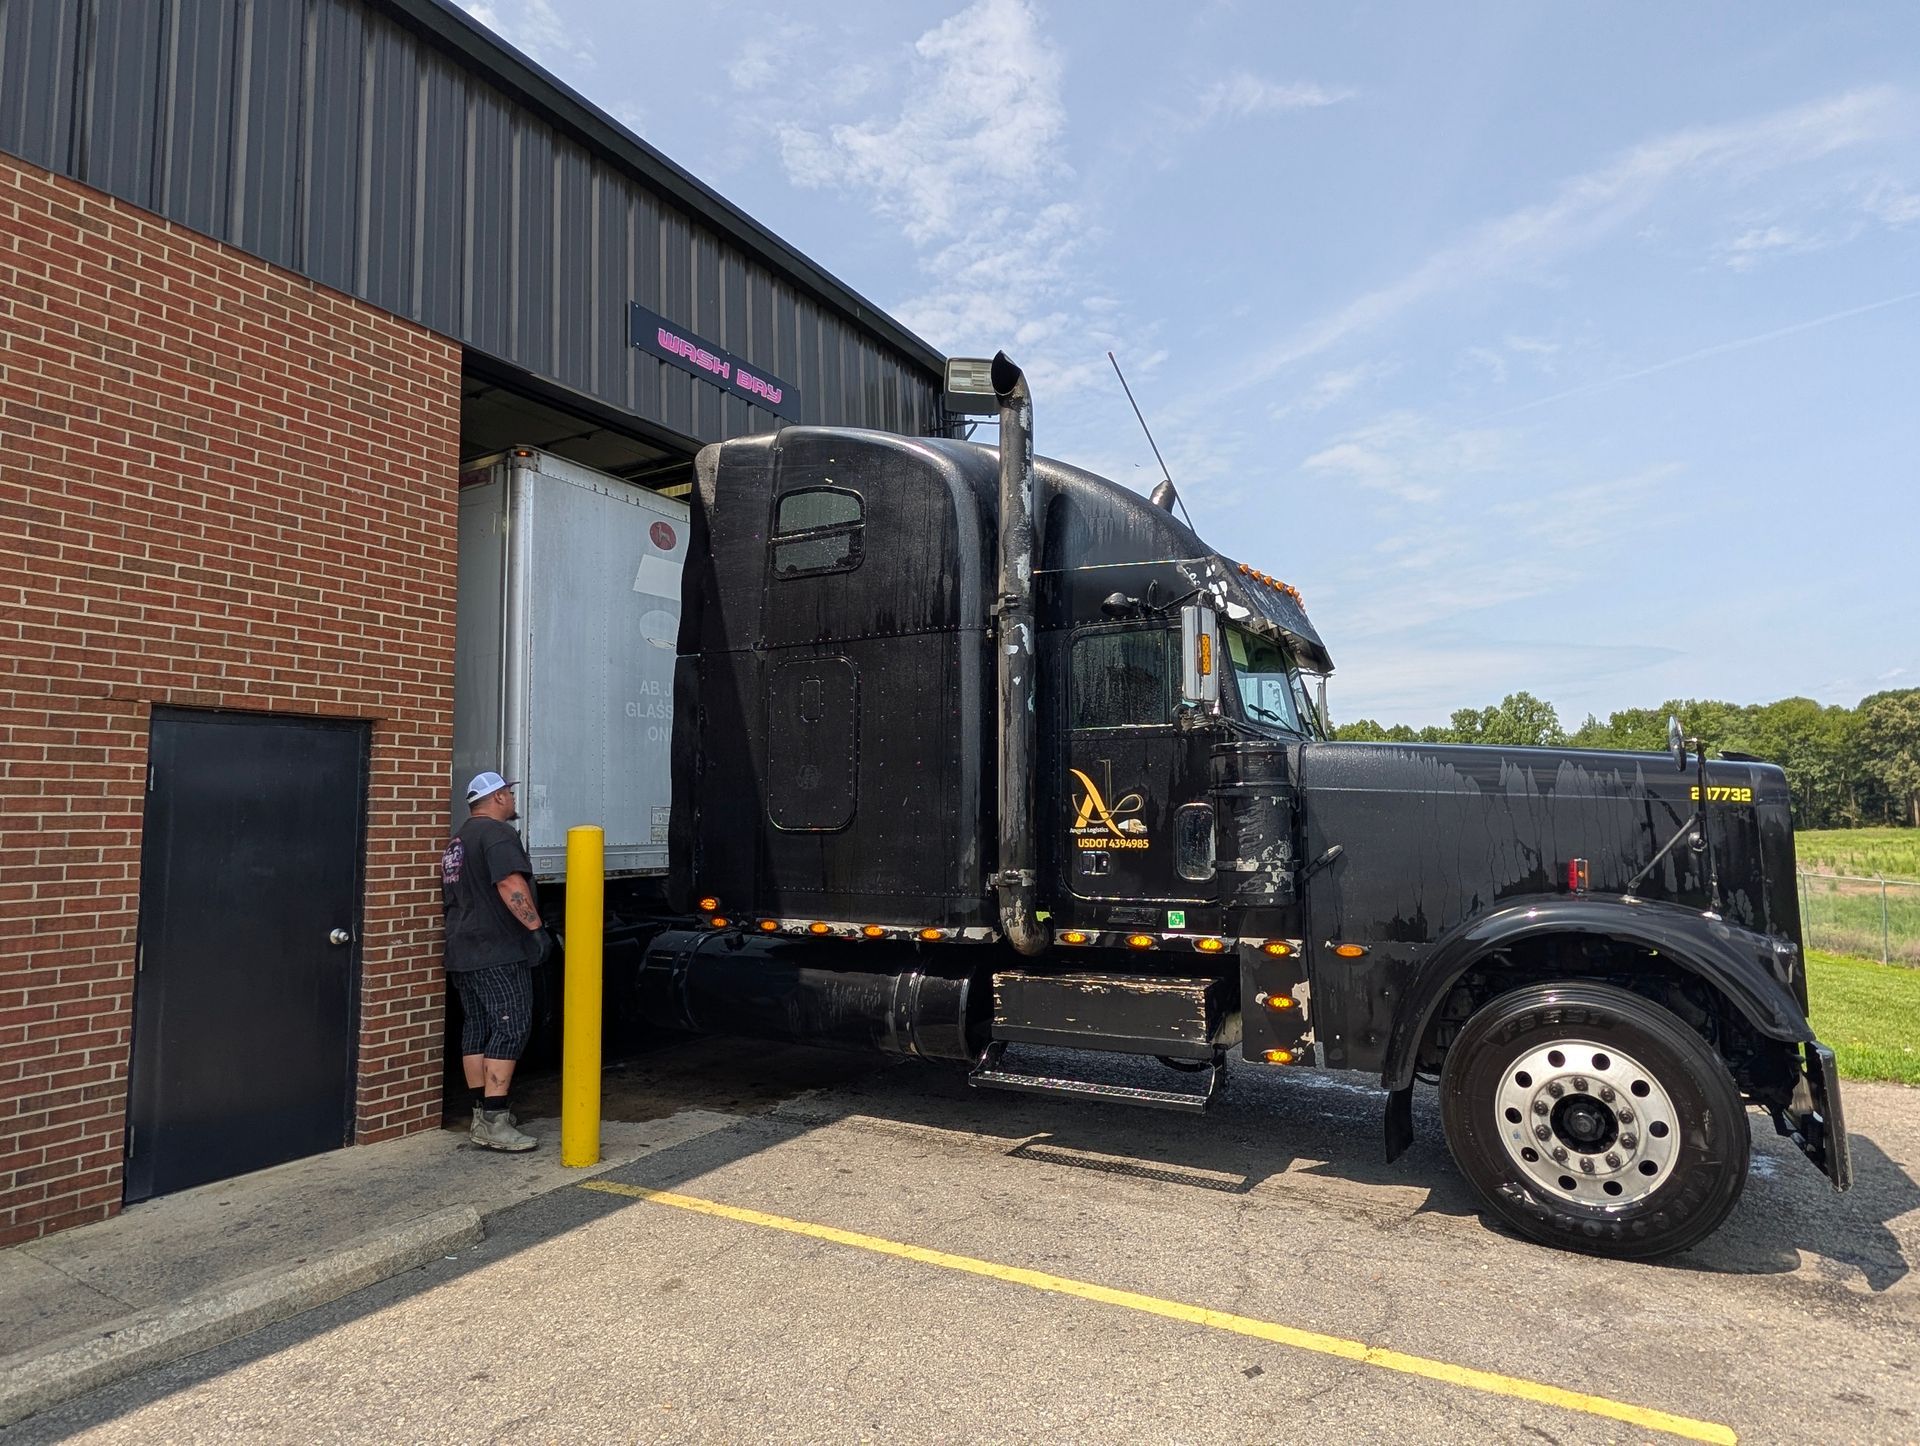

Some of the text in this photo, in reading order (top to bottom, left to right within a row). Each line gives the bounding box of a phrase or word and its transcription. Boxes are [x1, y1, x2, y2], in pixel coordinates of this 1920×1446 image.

[658, 327, 782, 404] WASH BAY
[1078, 838, 1149, 849] USDOT 4394985
